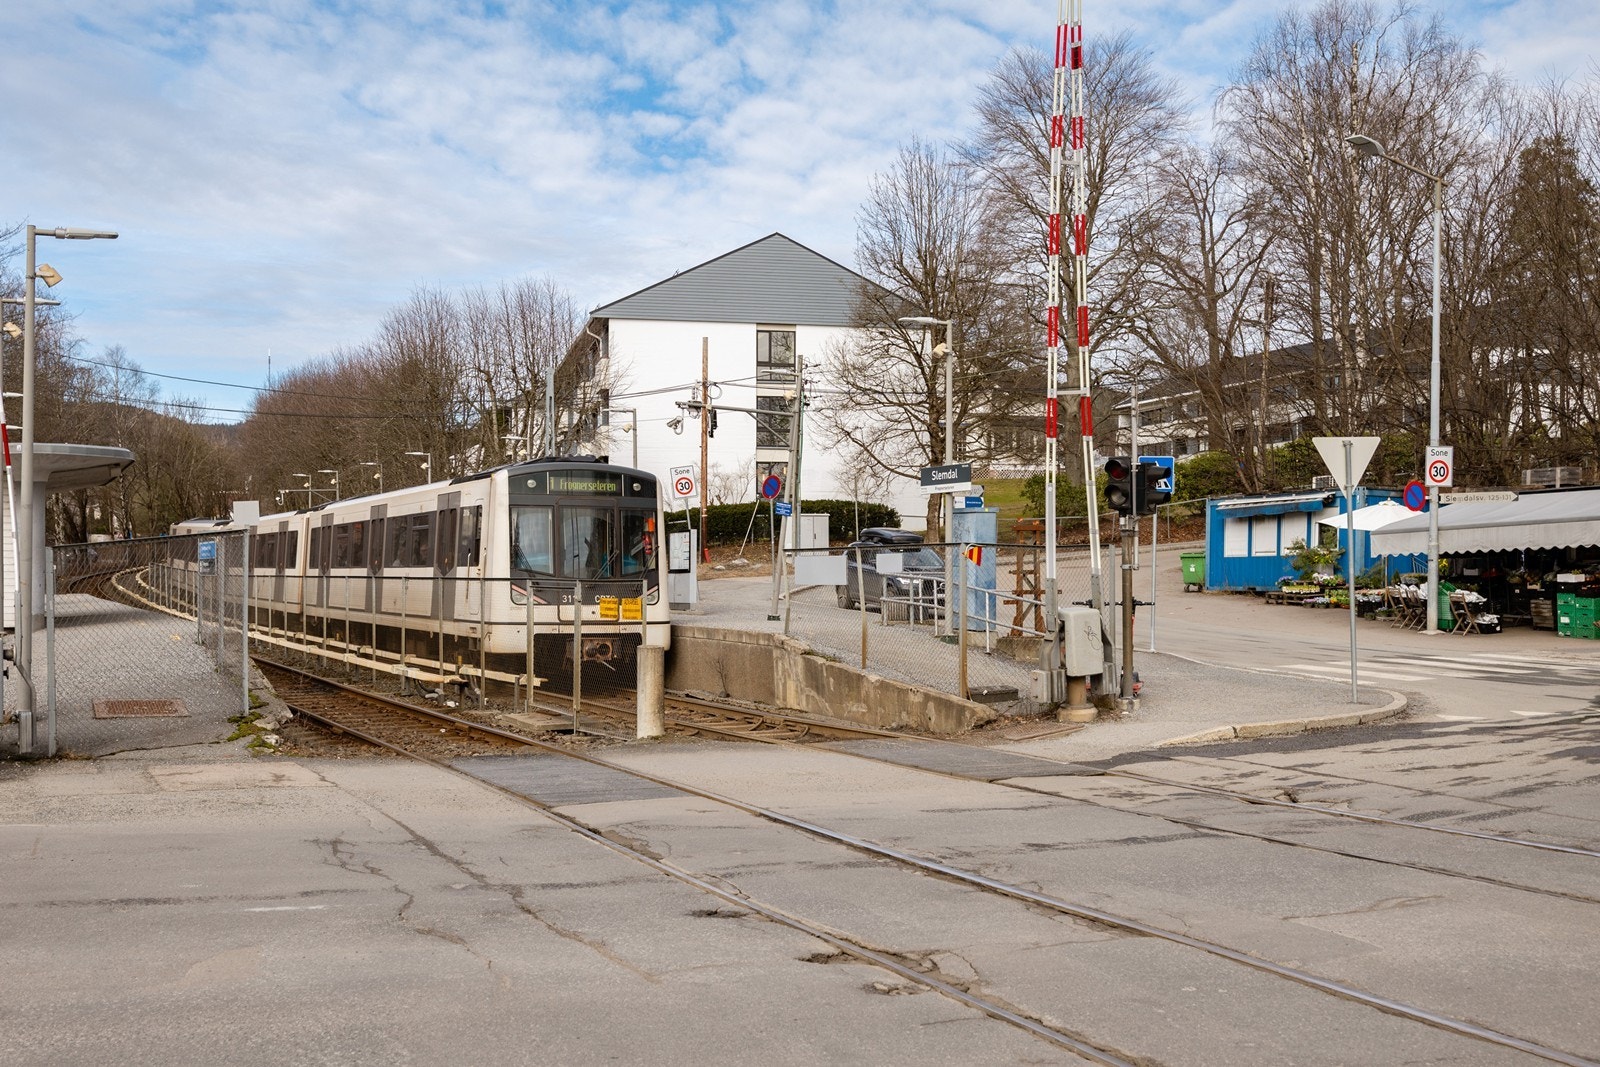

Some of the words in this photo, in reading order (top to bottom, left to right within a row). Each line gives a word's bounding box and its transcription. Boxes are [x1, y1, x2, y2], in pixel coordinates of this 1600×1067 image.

[1430, 448, 1448, 457] Sone
[931, 468, 958, 480] Slemdal
[1432, 466, 1445, 477] 30
[560, 479, 616, 492] Frognerseteren
[678, 482, 690, 491] 30
